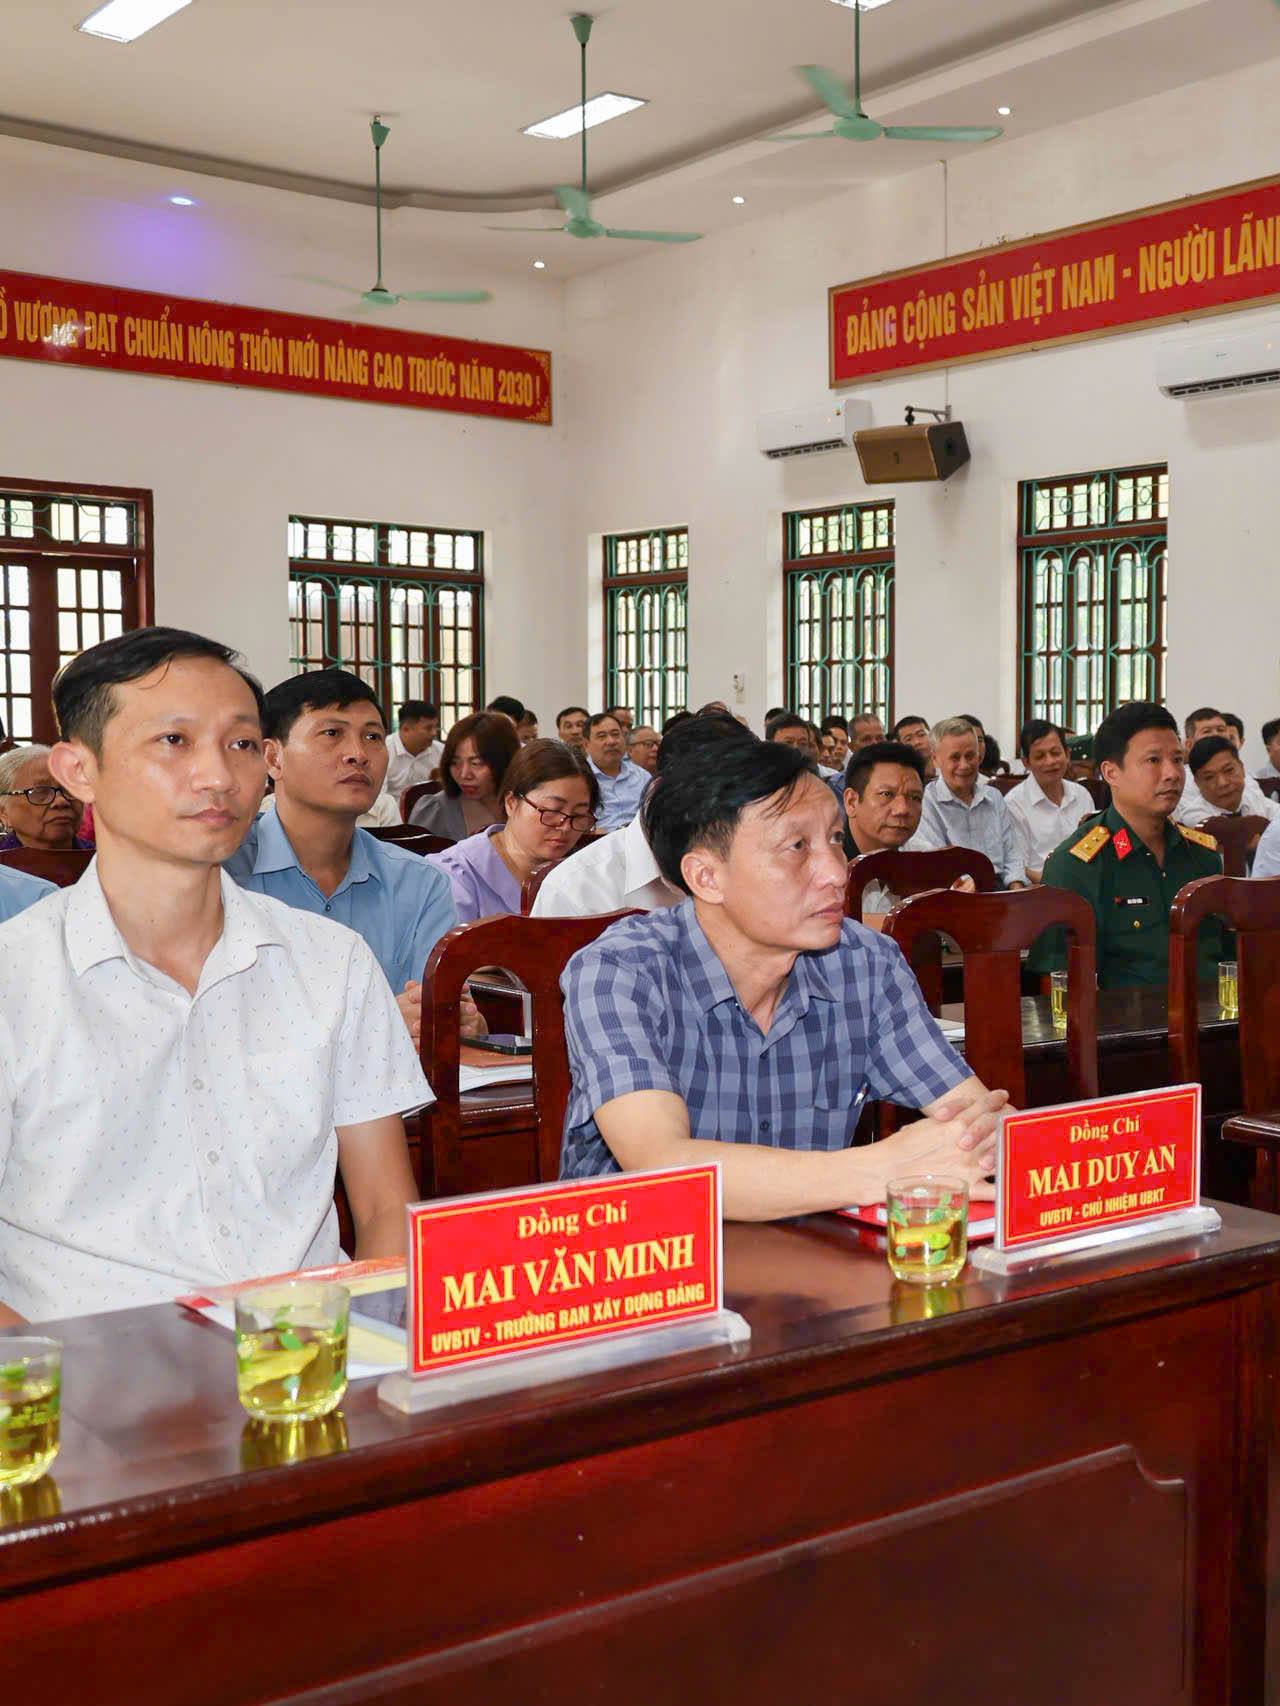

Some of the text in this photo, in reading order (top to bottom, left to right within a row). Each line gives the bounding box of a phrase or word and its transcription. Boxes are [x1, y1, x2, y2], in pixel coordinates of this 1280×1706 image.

[846, 298, 897, 355] ĐẢNG
[903, 290, 956, 349] CỘNG
[962, 270, 1004, 331] SẢN
[1010, 262, 1056, 325] VIỆT
[1062, 254, 1115, 310] NAM
[1139, 224, 1215, 294] NGƯỜI
[14, 299, 78, 348] VƯƠNG
[84, 311, 118, 357] ĐẠT
[124, 305, 183, 361] CHUẨN
[188, 320, 234, 369] NÔNG
[240, 328, 284, 375] THÔN
[288, 333, 319, 379] MỚI
[324, 339, 368, 385] NÂNG
[373, 352, 403, 390] CAO
[408, 352, 456, 397] TRƯỚC
[459, 358, 494, 401] NĂM
[498, 370, 533, 407] 2030
[1070, 1114, 1140, 1143] Đồng Chí
[1028, 1143, 1176, 1199] MAI DUY AN
[518, 1200, 627, 1239] Đồng Chí
[1040, 1206, 1073, 1226] UVBTV
[1082, 1195, 1102, 1218] CHỦ
[1105, 1191, 1137, 1213] NHIỆM
[1140, 1187, 1165, 1205] UBKT
[442, 1233, 695, 1313] MAI VĂN MINH
[431, 1327, 481, 1354] UVBTV
[559, 1307, 589, 1329] BAN
[593, 1298, 622, 1322] XÂY
[625, 1291, 663, 1317] DỰNG
[666, 1281, 705, 1307] ĐẢNG
